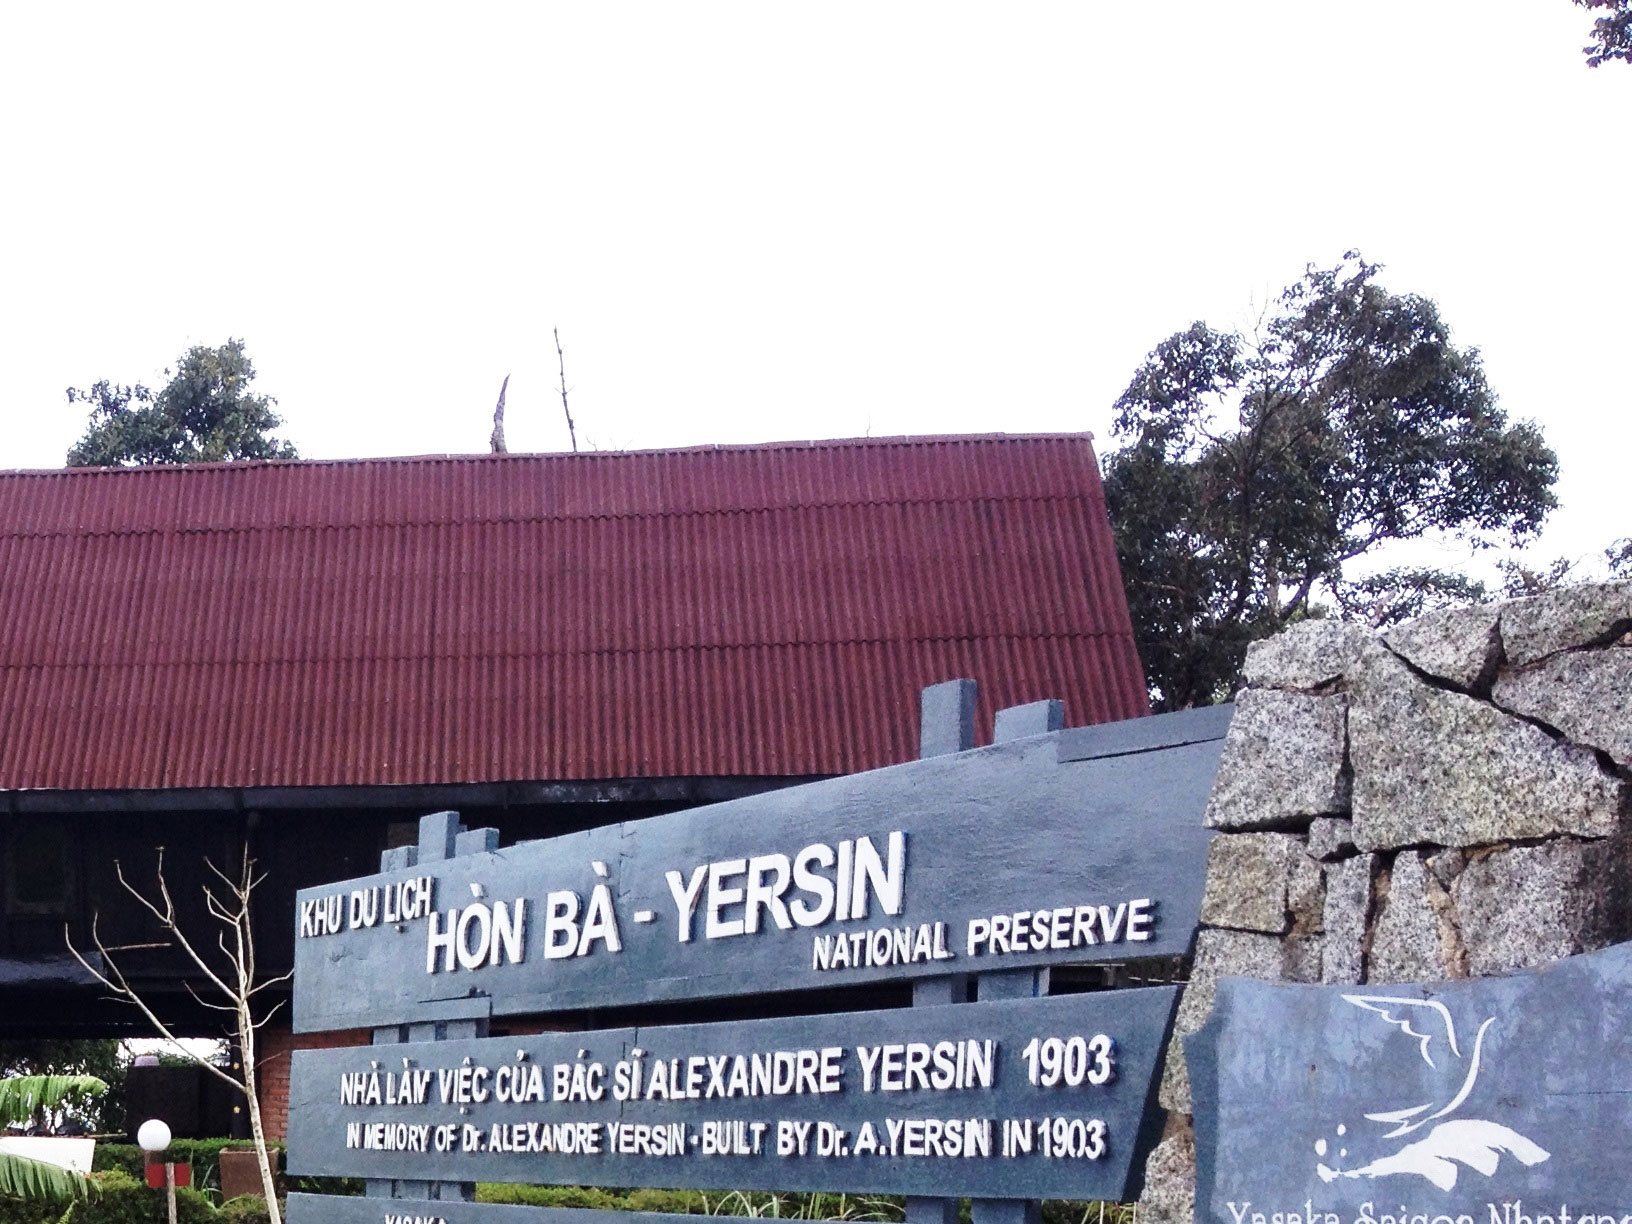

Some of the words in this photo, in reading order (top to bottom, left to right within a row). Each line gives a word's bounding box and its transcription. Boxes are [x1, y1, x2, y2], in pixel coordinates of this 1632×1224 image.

[301, 895, 344, 938] KHU
[349, 888, 378, 930] DU
[384, 876, 433, 933] LỊCH
[427, 883, 525, 973] HÒN
[544, 860, 623, 960] BÀ
[665, 831, 907, 942] YERSIN
[813, 921, 954, 970] NATIONAL
[968, 899, 1152, 957] PRESERVE
[341, 1060, 381, 1105] NHÀ
[438, 1056, 489, 1115] VIỆC
[495, 1049, 545, 1103] CỦA
[553, 1050, 607, 1102] BÁC
[646, 1047, 842, 1101] ALEXANDRE
[857, 1039, 995, 1093] YERSIN
[1022, 1034, 1113, 1087] 1903
[346, 1121, 360, 1149] IN
[364, 1122, 430, 1152] MEMORY
[435, 1124, 457, 1151] OF
[463, 1123, 486, 1152] Dr.
[489, 1122, 601, 1154] ALEXANDRE
[606, 1121, 685, 1155] YERSIN
[703, 1120, 766, 1155] BUILT
[777, 1120, 812, 1156] BY
[817, 1121, 848, 1157] Dr.
[1002, 1119, 1032, 1158] IN
[1037, 1117, 1107, 1160] 1903
